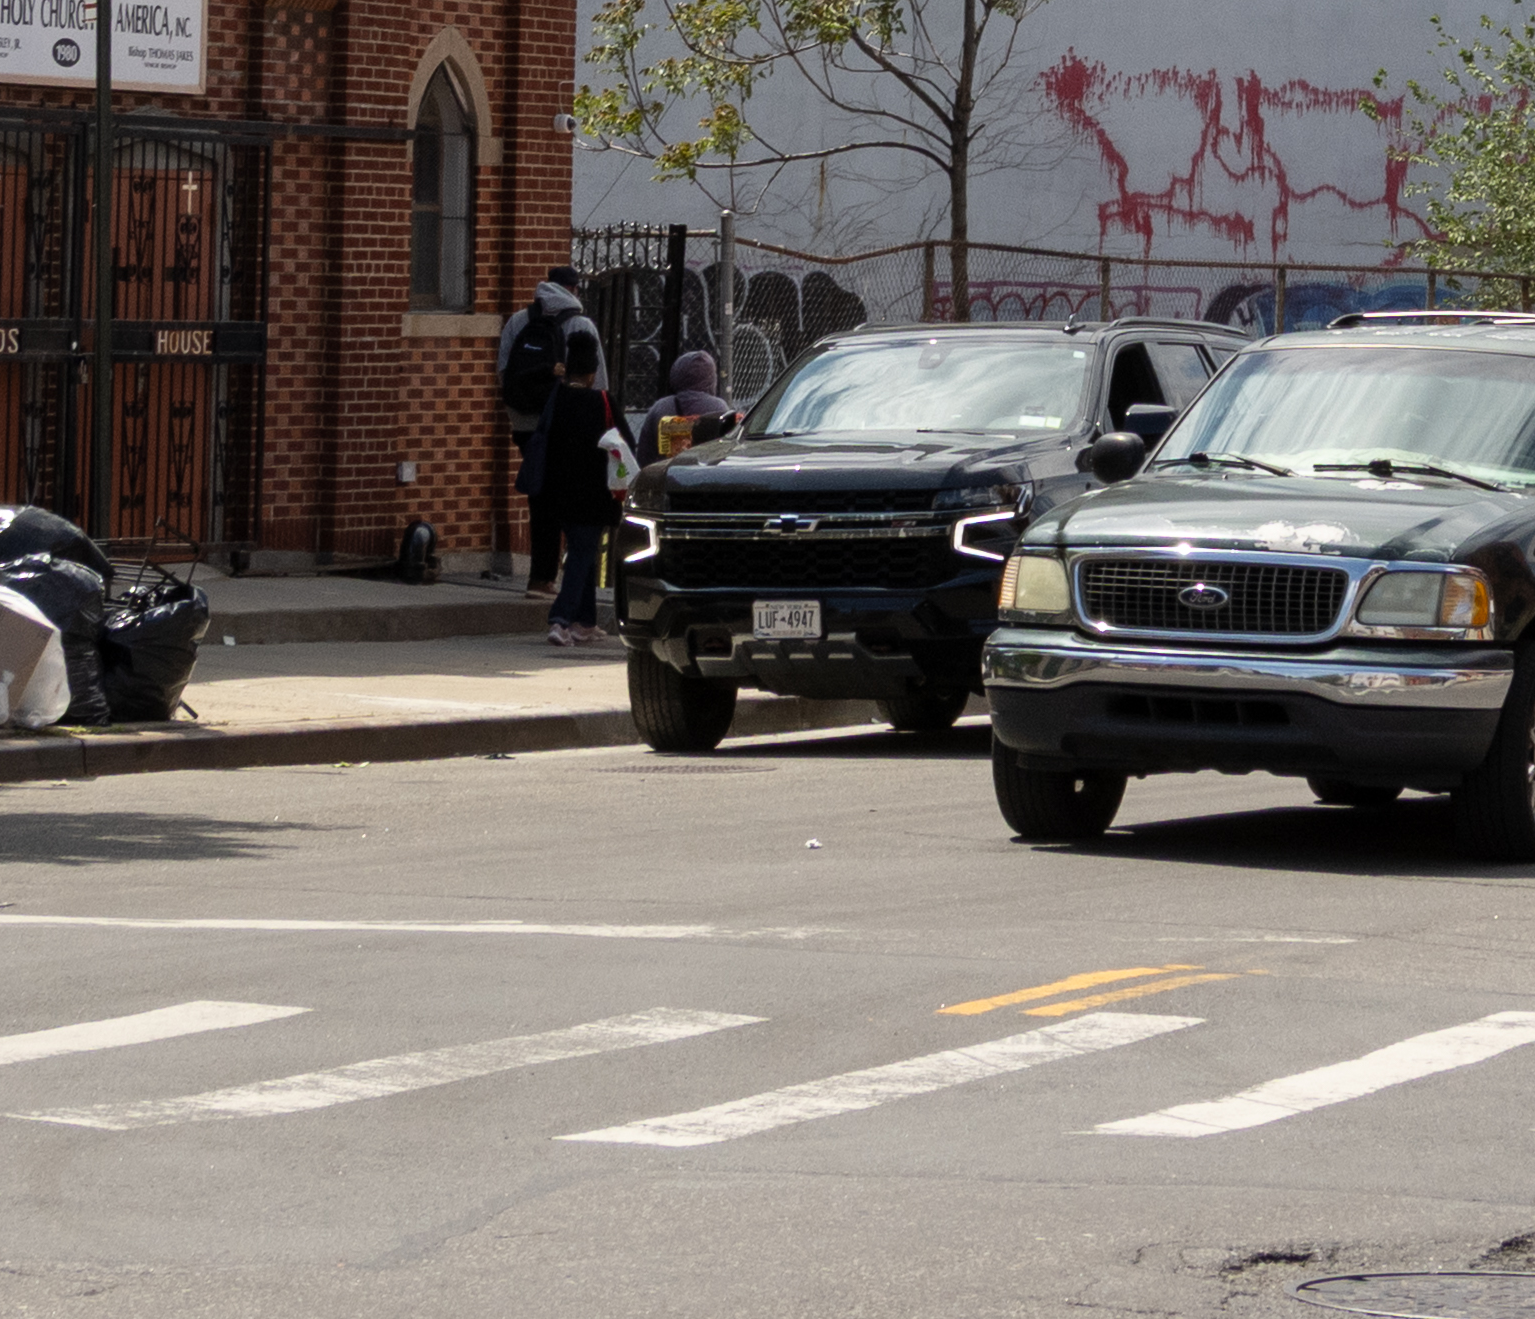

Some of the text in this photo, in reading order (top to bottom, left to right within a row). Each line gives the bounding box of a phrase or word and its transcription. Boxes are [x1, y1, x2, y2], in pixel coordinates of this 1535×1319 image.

[115, 3, 174, 43] AMERICA,
[55, 44, 78, 62] 1980
[156, 329, 214, 355] HOUSE
